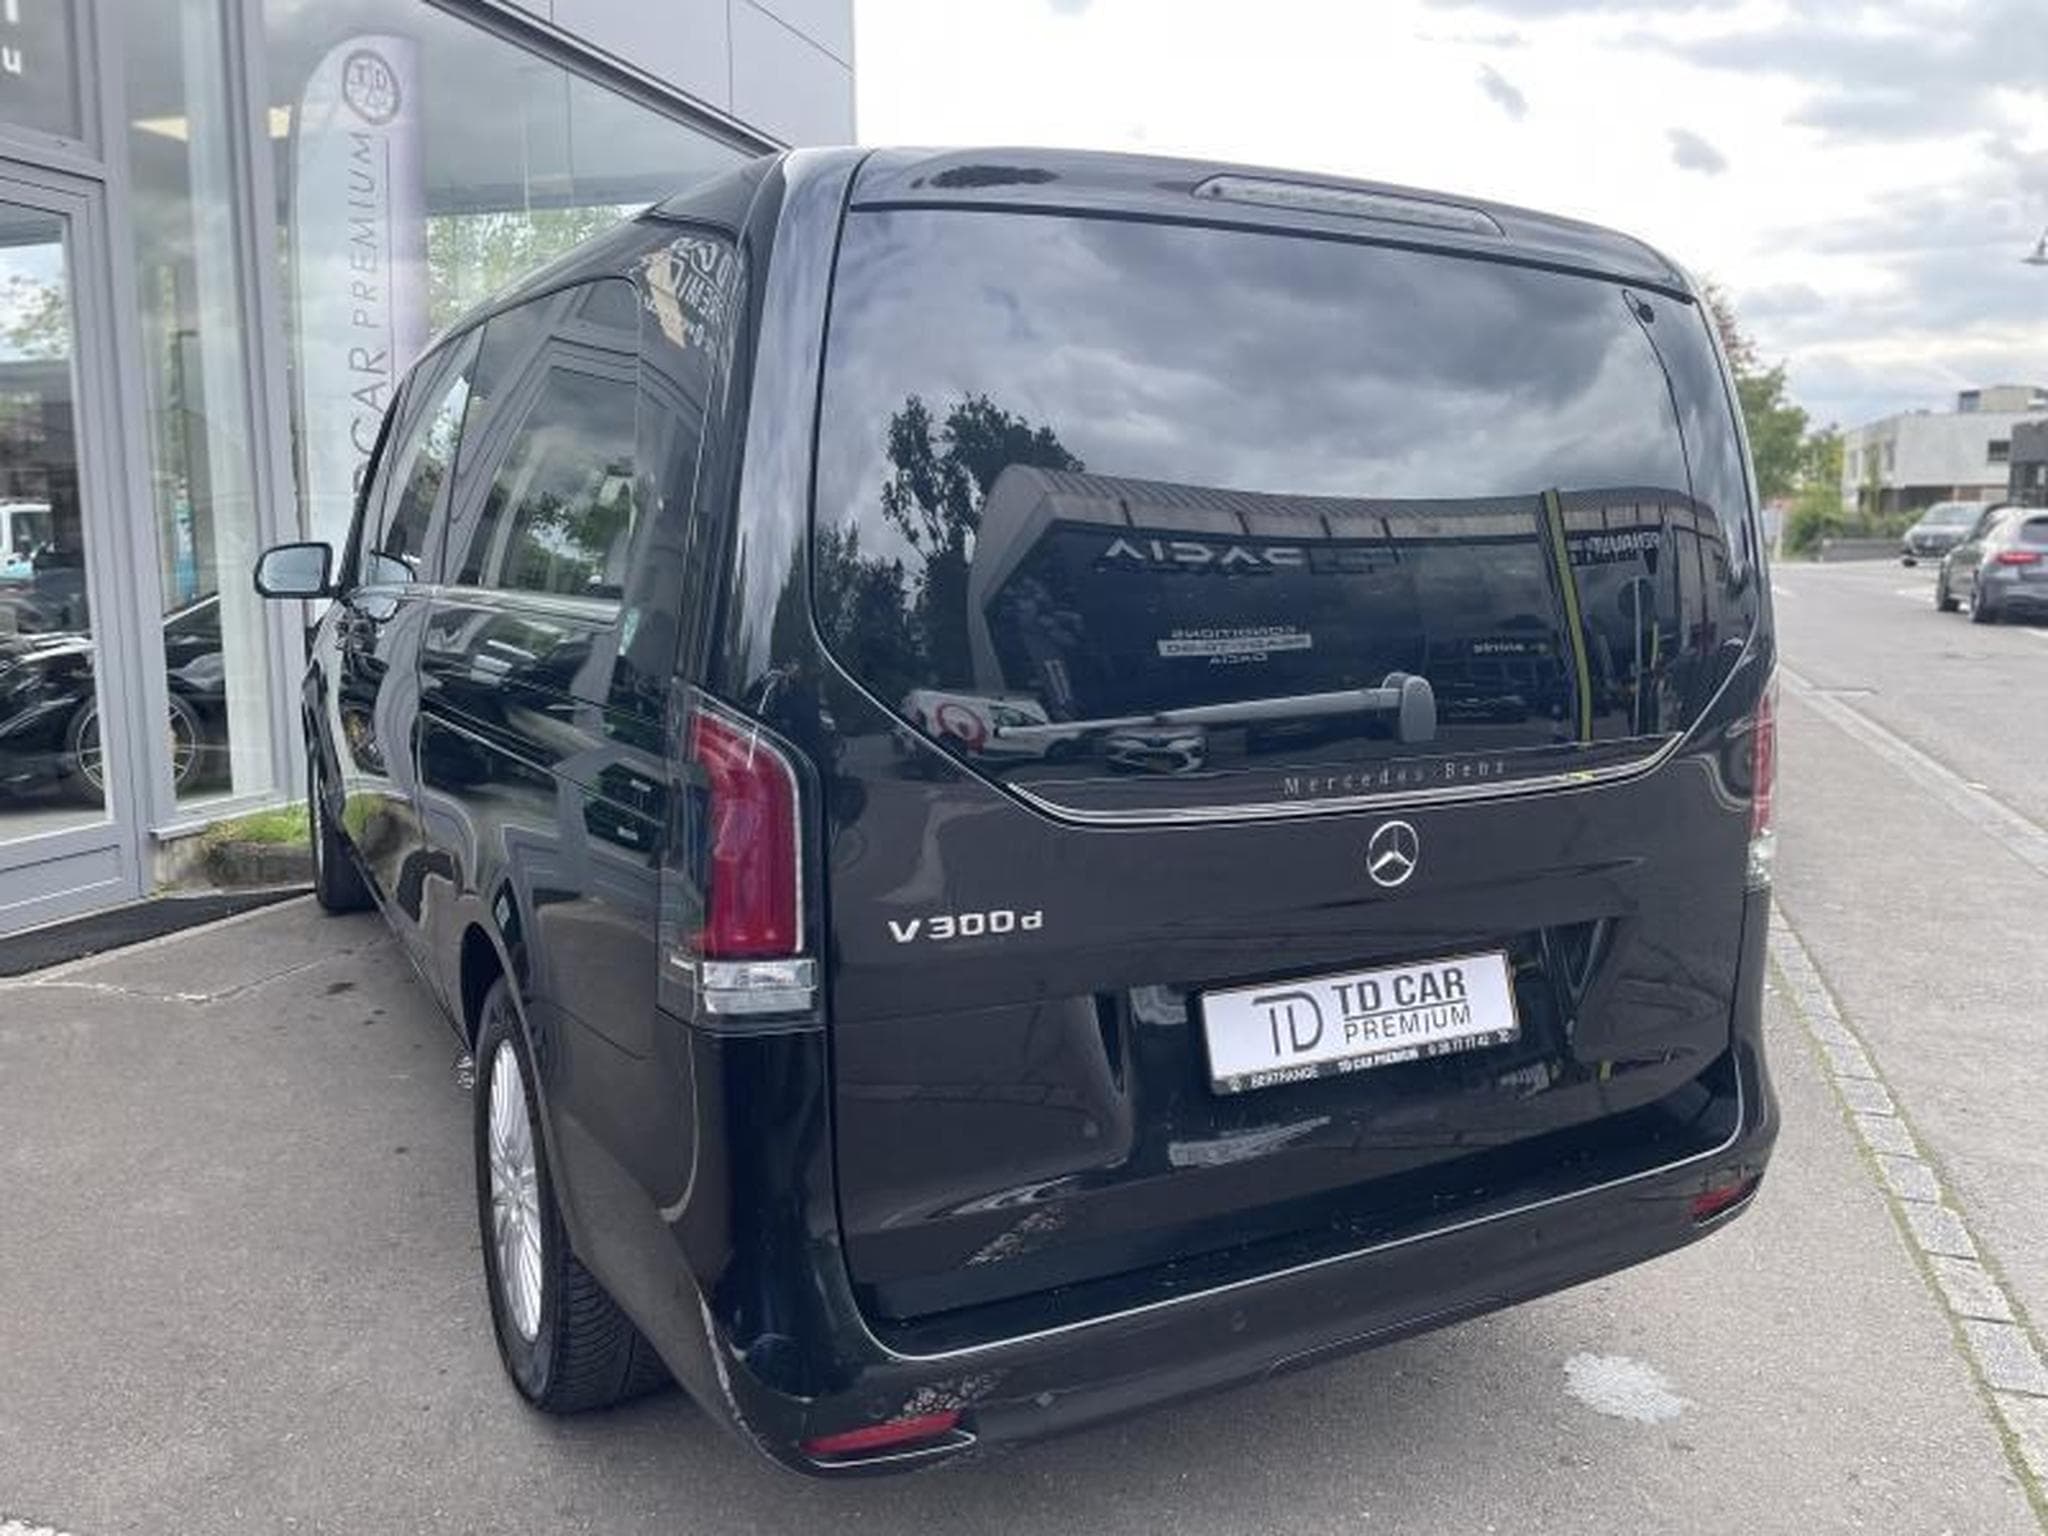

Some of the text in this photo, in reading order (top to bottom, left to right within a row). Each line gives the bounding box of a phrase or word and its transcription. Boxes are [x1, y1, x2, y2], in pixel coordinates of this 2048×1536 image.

[347, 131, 380, 330] PREMIUM
[1331, 967, 1467, 1015] TD CAR
[1344, 1003, 1472, 1044] PREMIUM
